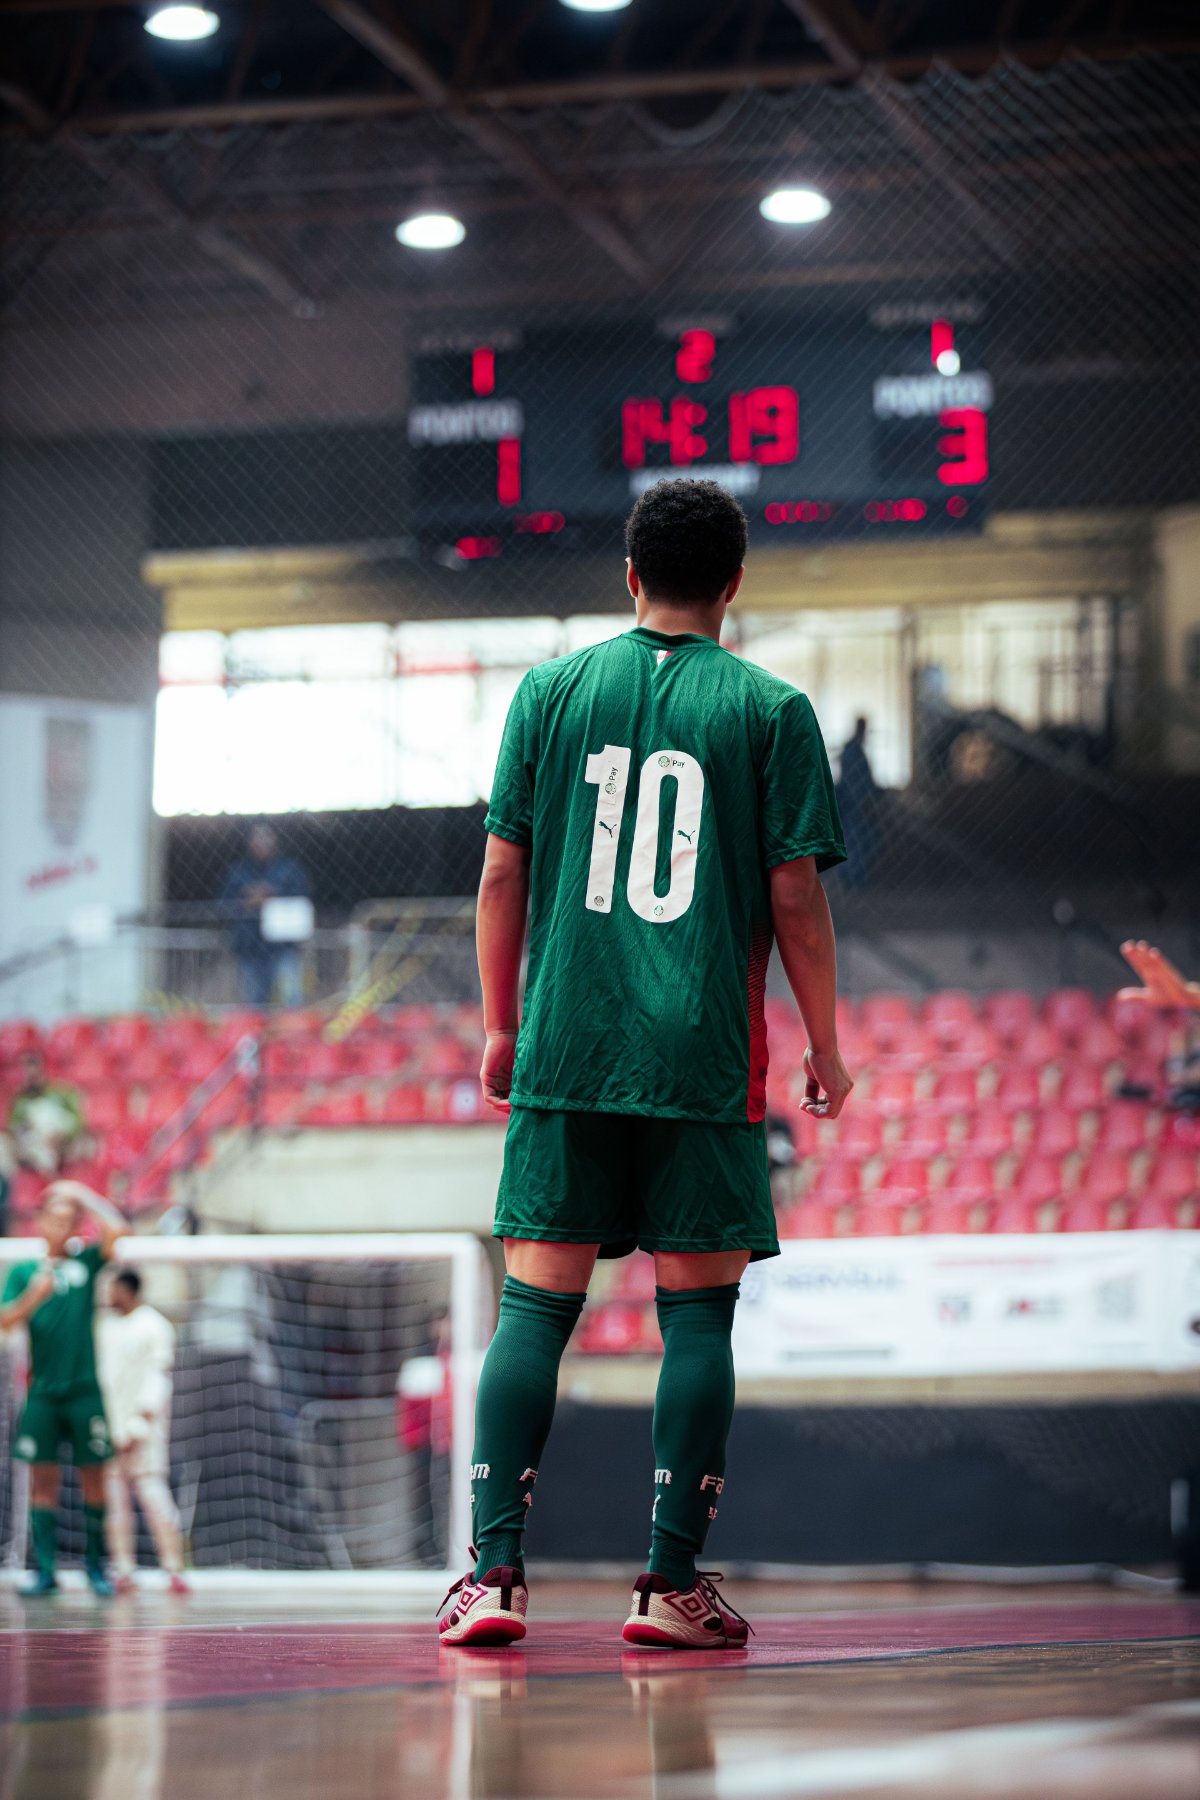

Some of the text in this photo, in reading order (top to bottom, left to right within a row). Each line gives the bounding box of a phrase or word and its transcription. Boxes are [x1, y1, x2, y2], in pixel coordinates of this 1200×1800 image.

[937, 407, 989, 486] 3
[672, 759, 685, 769] Pay
[584, 744, 705, 923] 10
